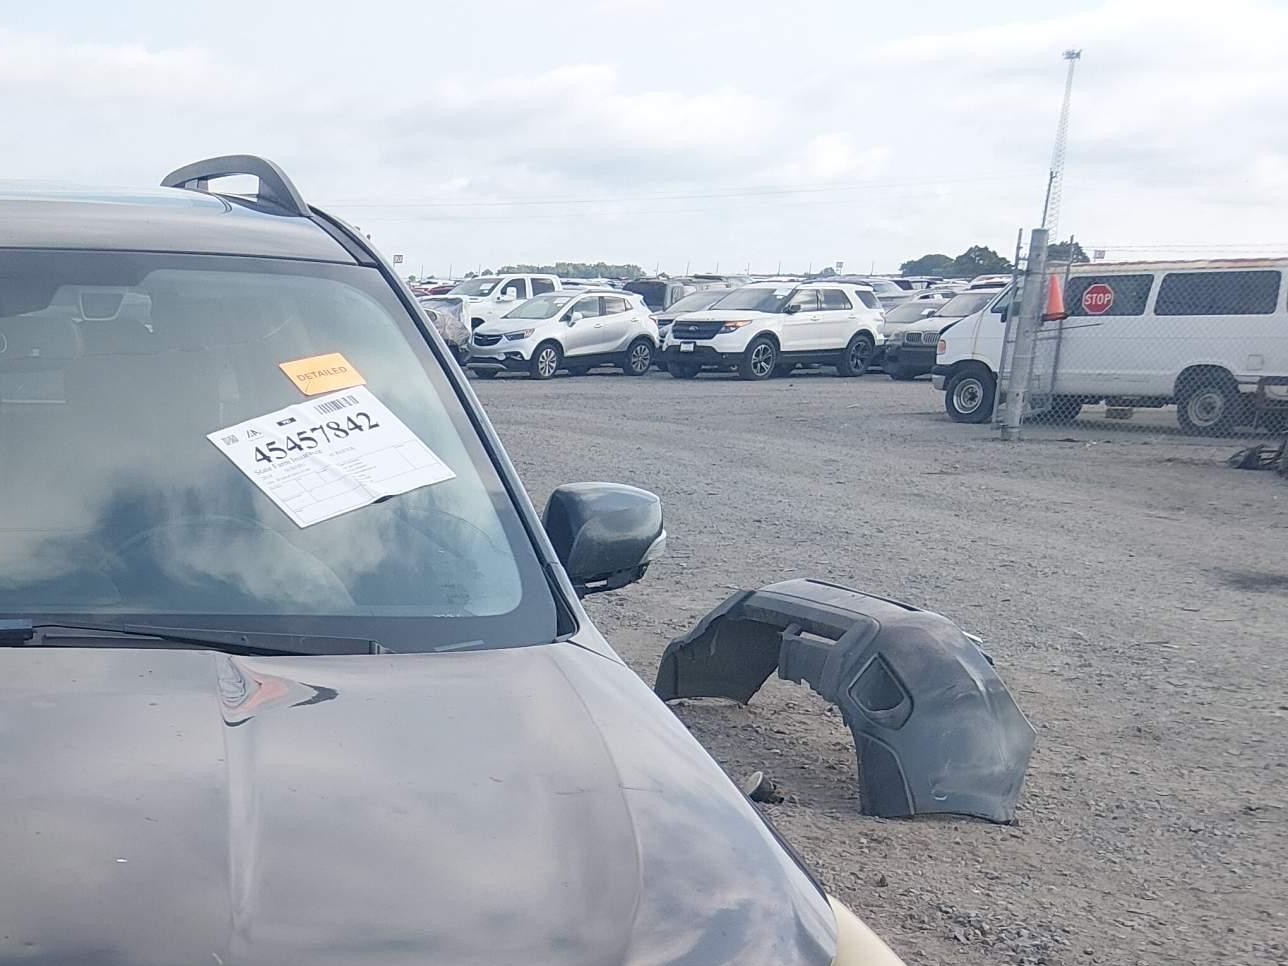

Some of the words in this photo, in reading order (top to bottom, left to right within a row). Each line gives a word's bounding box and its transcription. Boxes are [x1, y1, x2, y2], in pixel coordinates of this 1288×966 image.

[1085, 293, 1111, 305] STOP
[296, 366, 348, 382] DETAILED
[254, 412, 380, 463] 45457842
